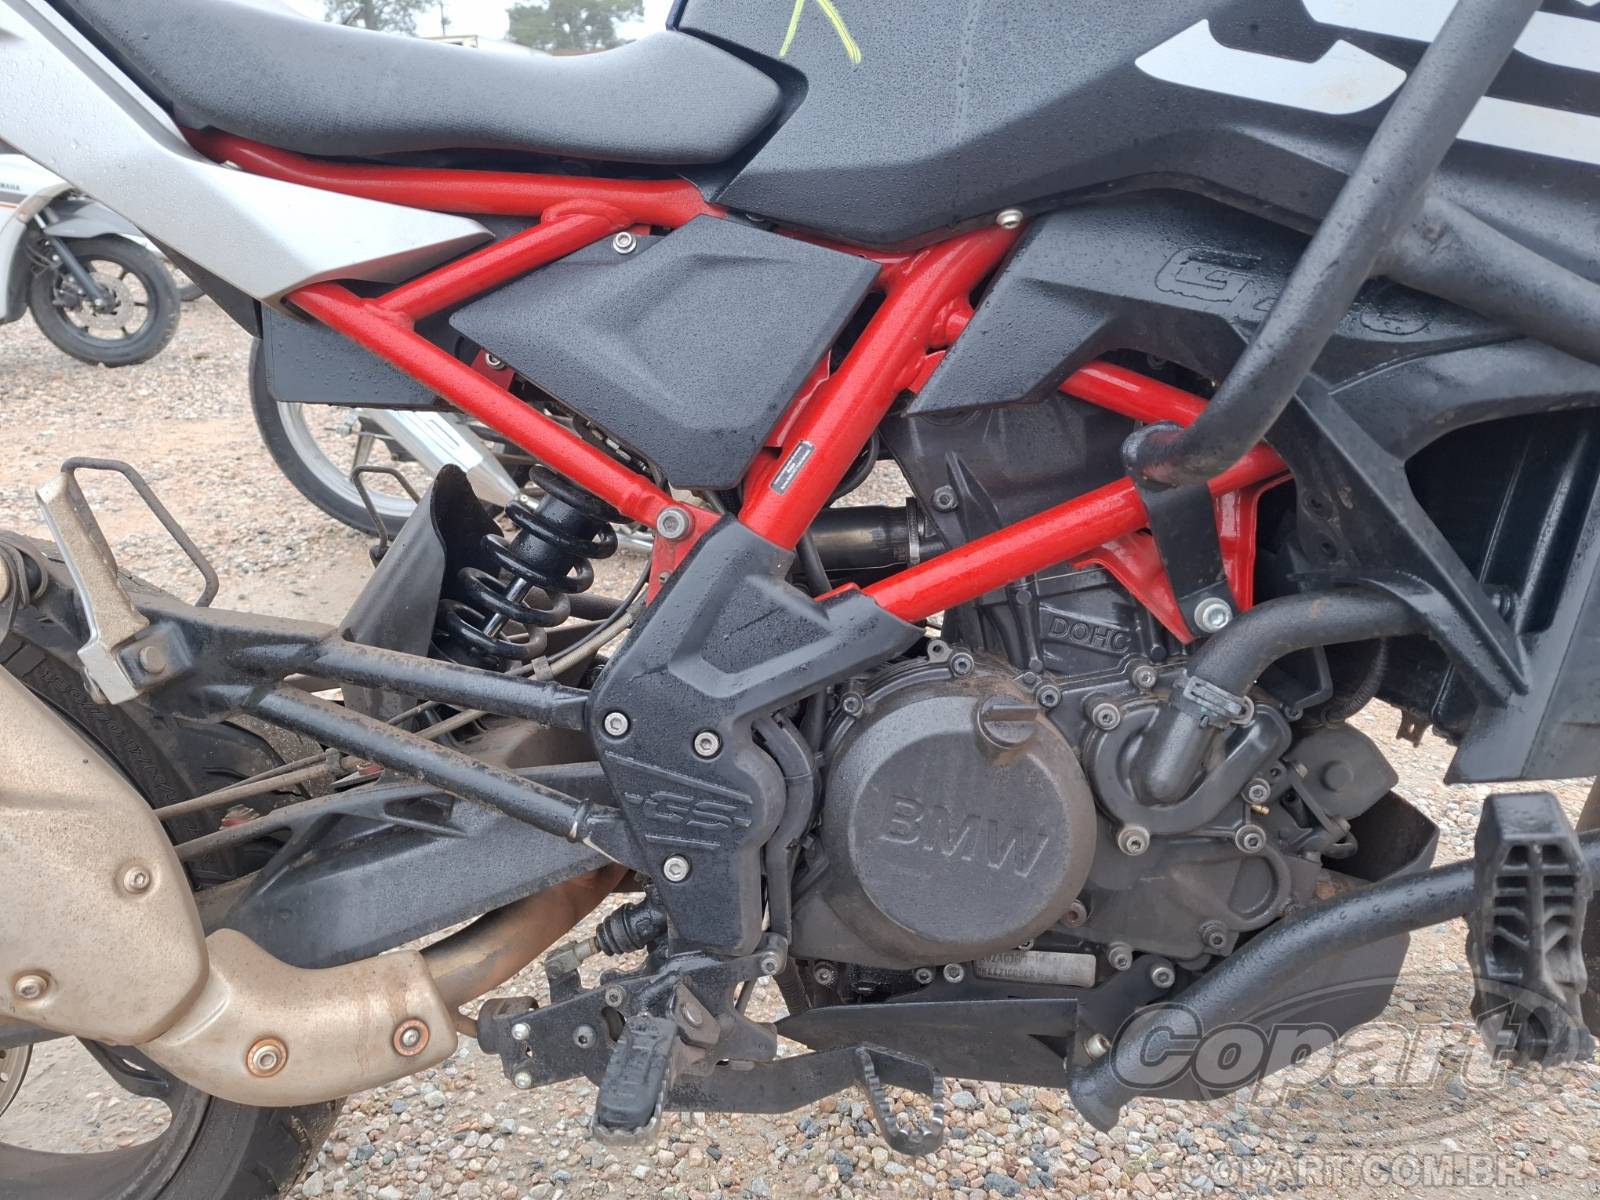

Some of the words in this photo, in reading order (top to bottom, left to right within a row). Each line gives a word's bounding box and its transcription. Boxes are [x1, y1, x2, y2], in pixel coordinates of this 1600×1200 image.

[1048, 616, 1131, 653] DOHC
[642, 790, 738, 831] GS
[877, 795, 1049, 878] BMW
